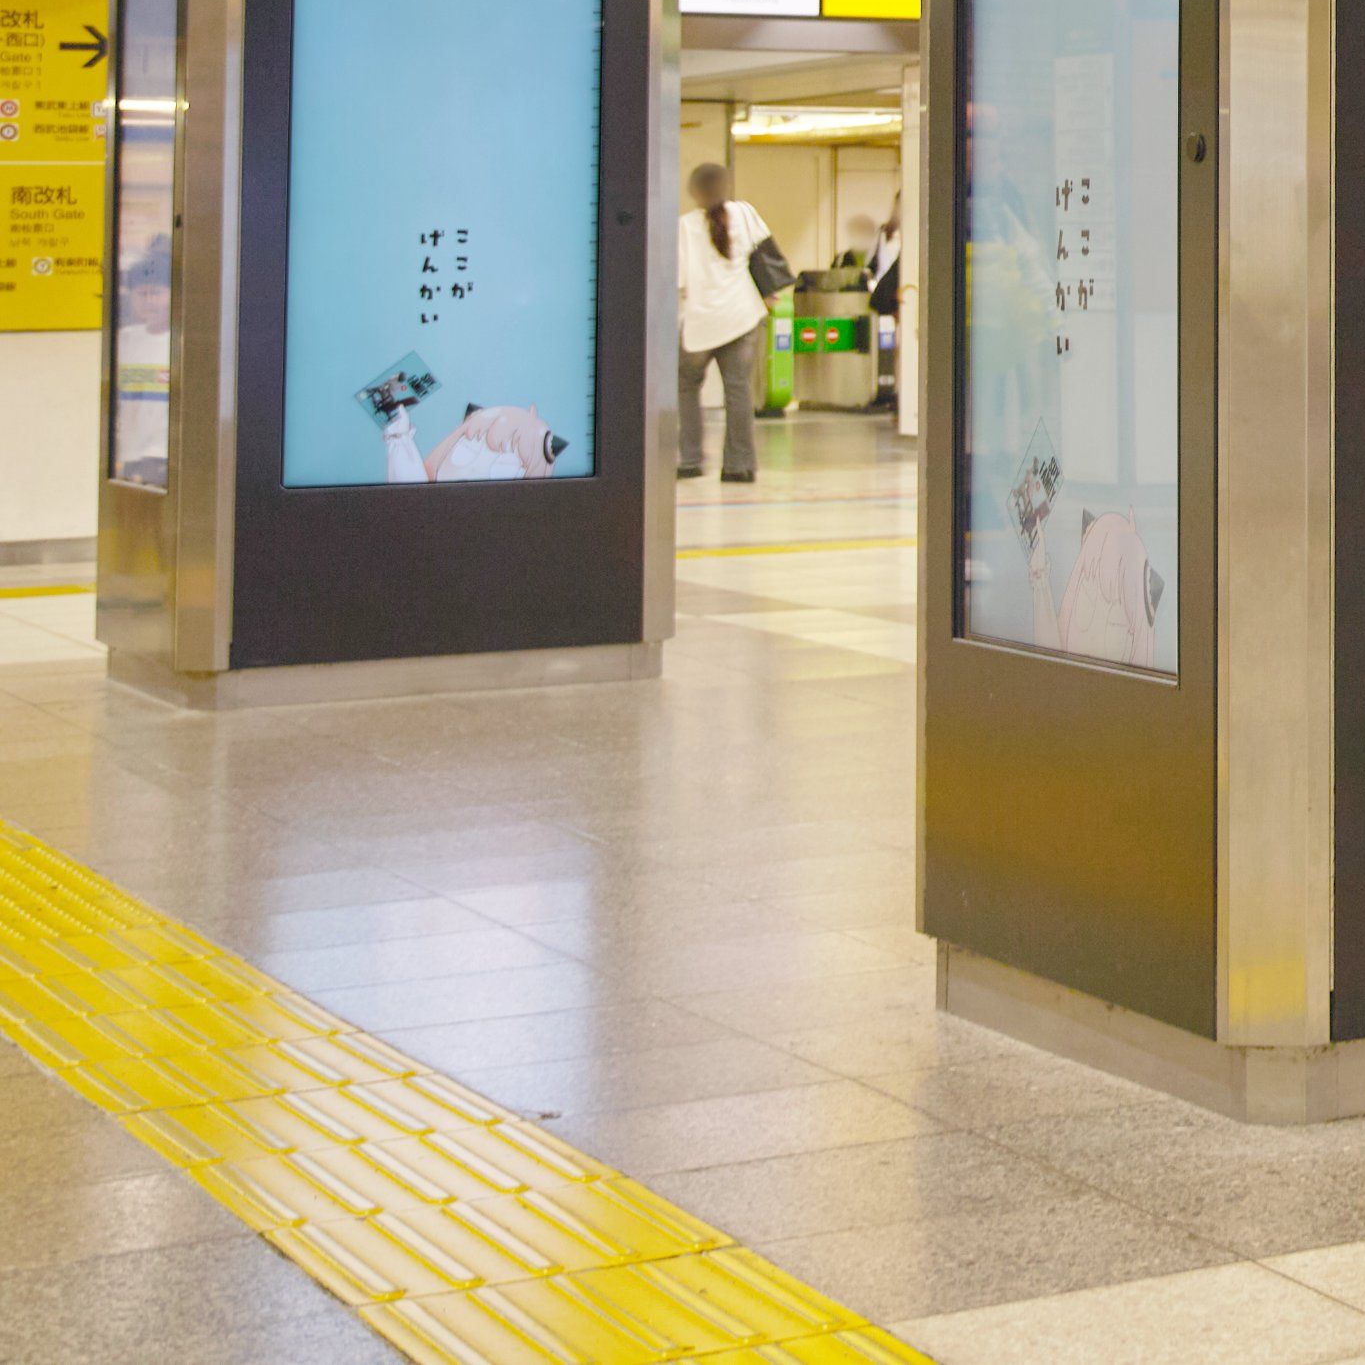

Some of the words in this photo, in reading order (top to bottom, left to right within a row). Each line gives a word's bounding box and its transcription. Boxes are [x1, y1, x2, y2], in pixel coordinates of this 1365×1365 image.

[10, 209, 50, 220] South
[53, 209, 86, 220] Gate
[11, 186, 78, 205] 南改札
[419, 229, 446, 324] げんかい
[451, 229, 475, 300] ここが
[1055, 179, 1073, 356] げんかい
[1078, 178, 1094, 311] ここが
